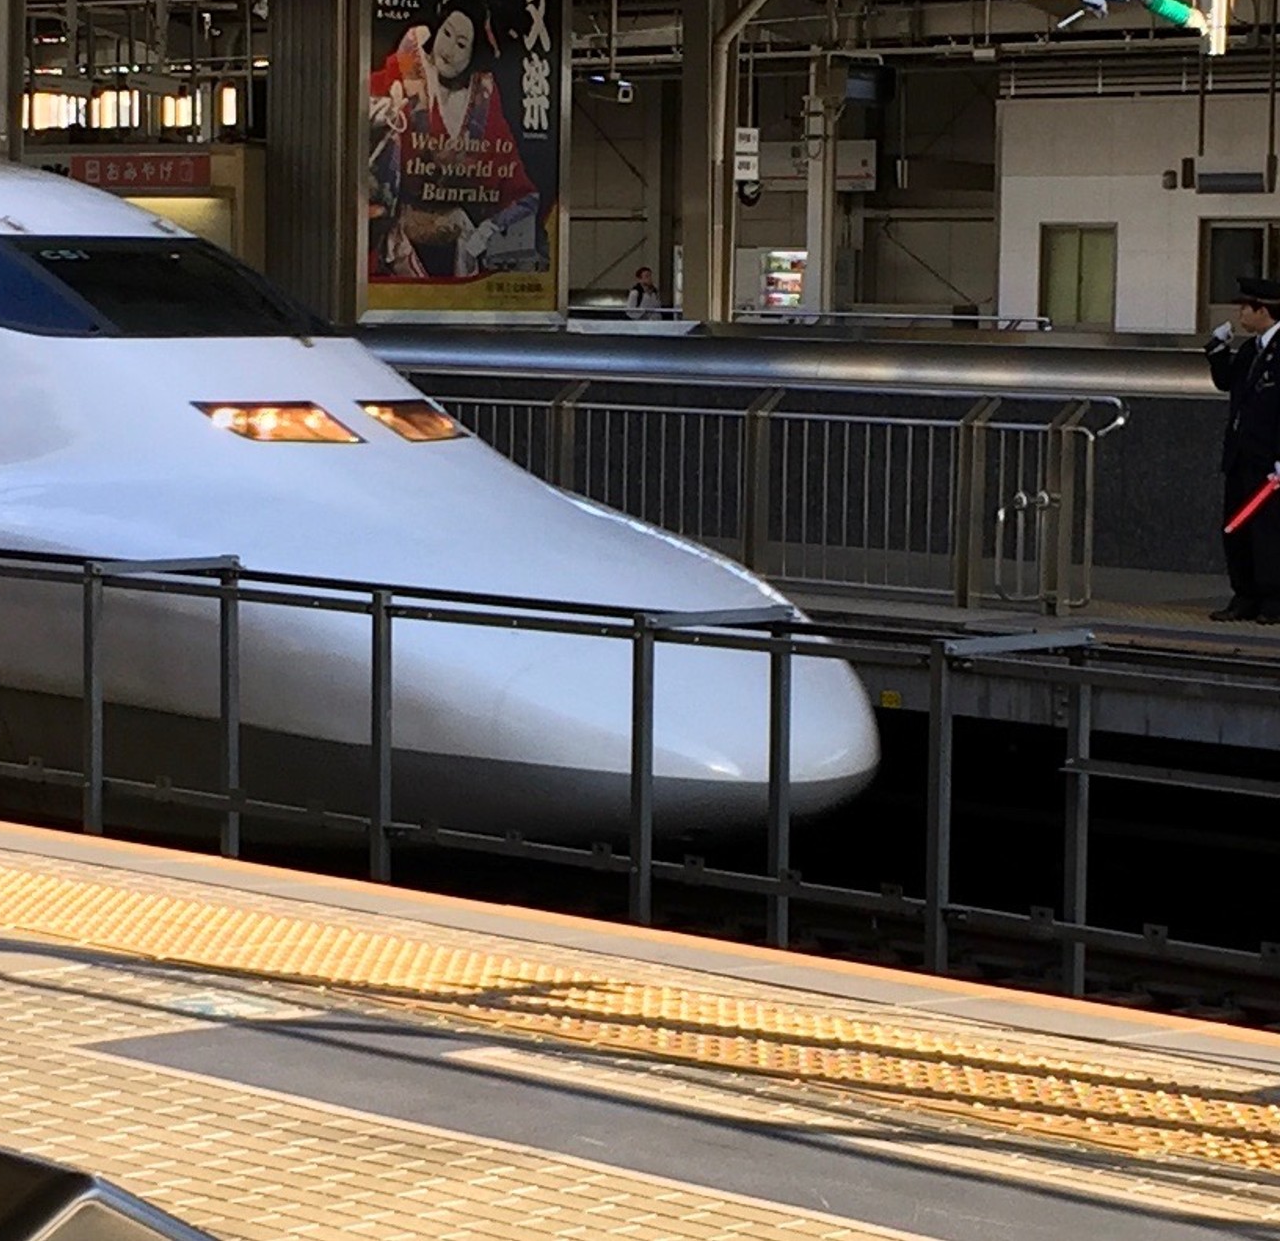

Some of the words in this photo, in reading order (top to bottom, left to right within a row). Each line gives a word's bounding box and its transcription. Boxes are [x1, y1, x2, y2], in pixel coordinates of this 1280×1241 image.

[410, 132, 491, 153] Welcome
[495, 138, 514, 154] to
[106, 161, 173, 182] おみやげ
[406, 157, 437, 176] the
[440, 160, 494, 178] world
[497, 161, 518, 179] of
[422, 182, 501, 203] Bunraku
